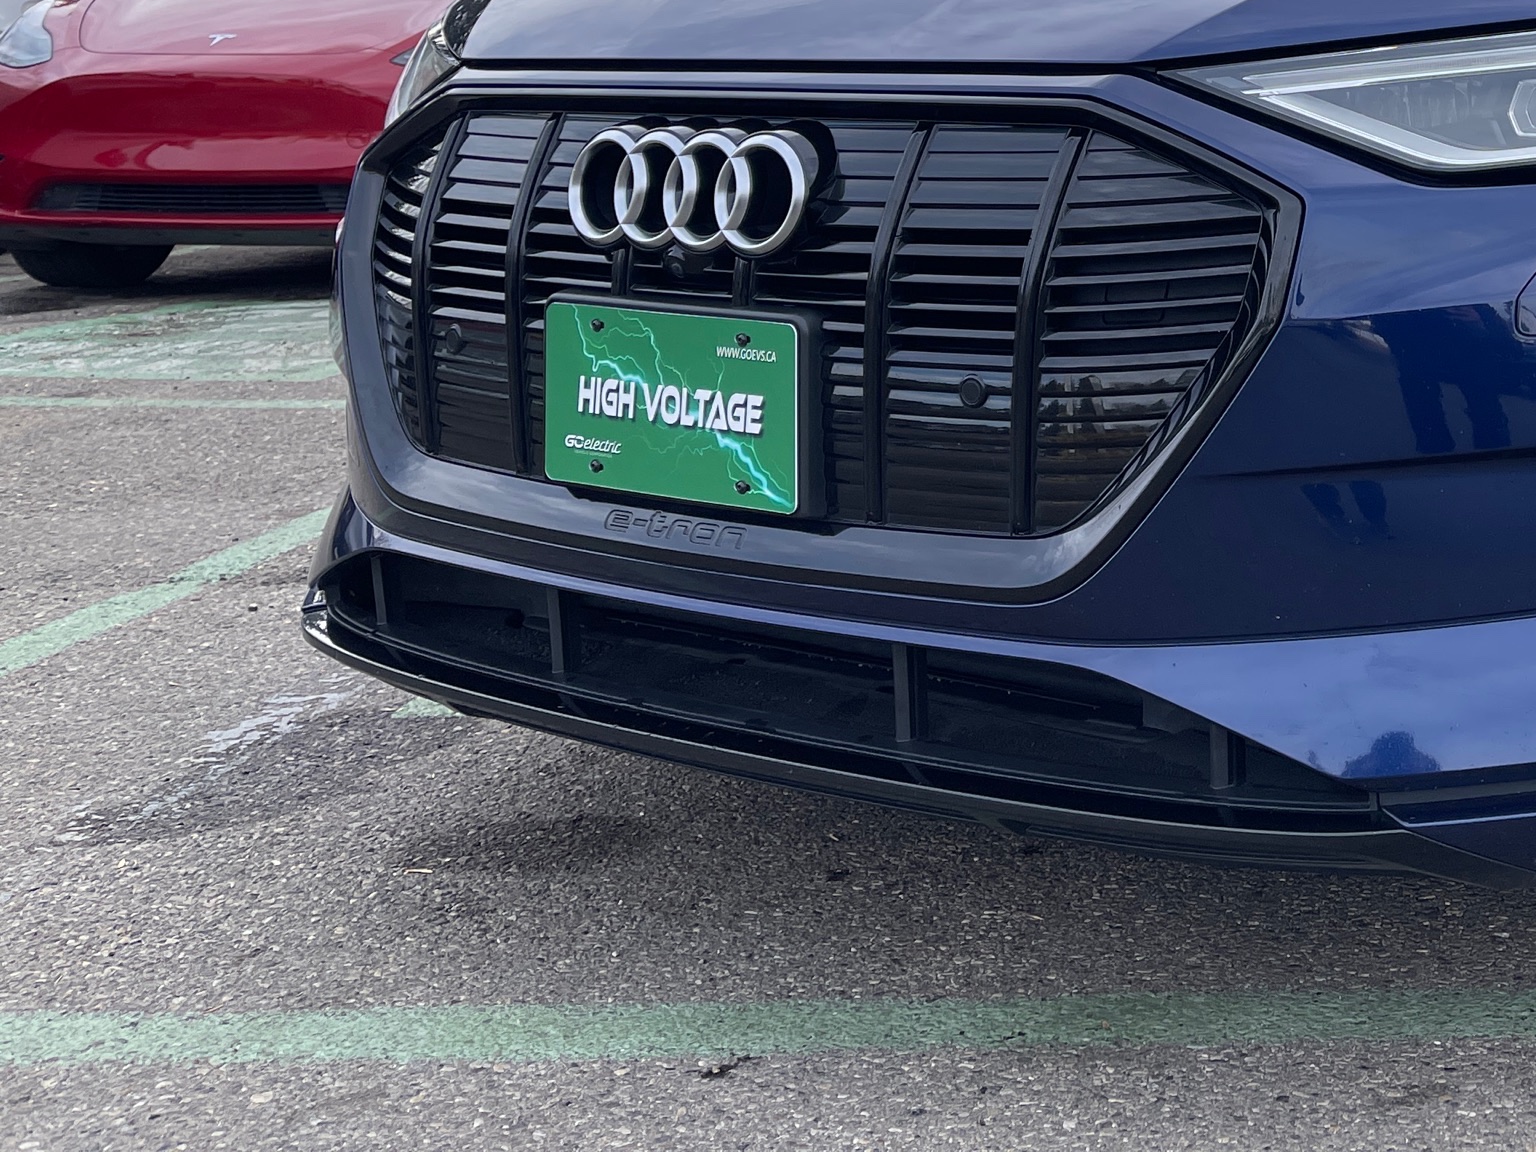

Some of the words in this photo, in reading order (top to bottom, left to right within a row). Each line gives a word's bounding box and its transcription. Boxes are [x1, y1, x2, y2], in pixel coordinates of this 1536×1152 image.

[716, 346, 777, 363] WWW.GOEVS.CA
[577, 375, 636, 419] HIGH
[643, 384, 764, 435] VOLTAGE
[604, 508, 748, 550] e-tron
